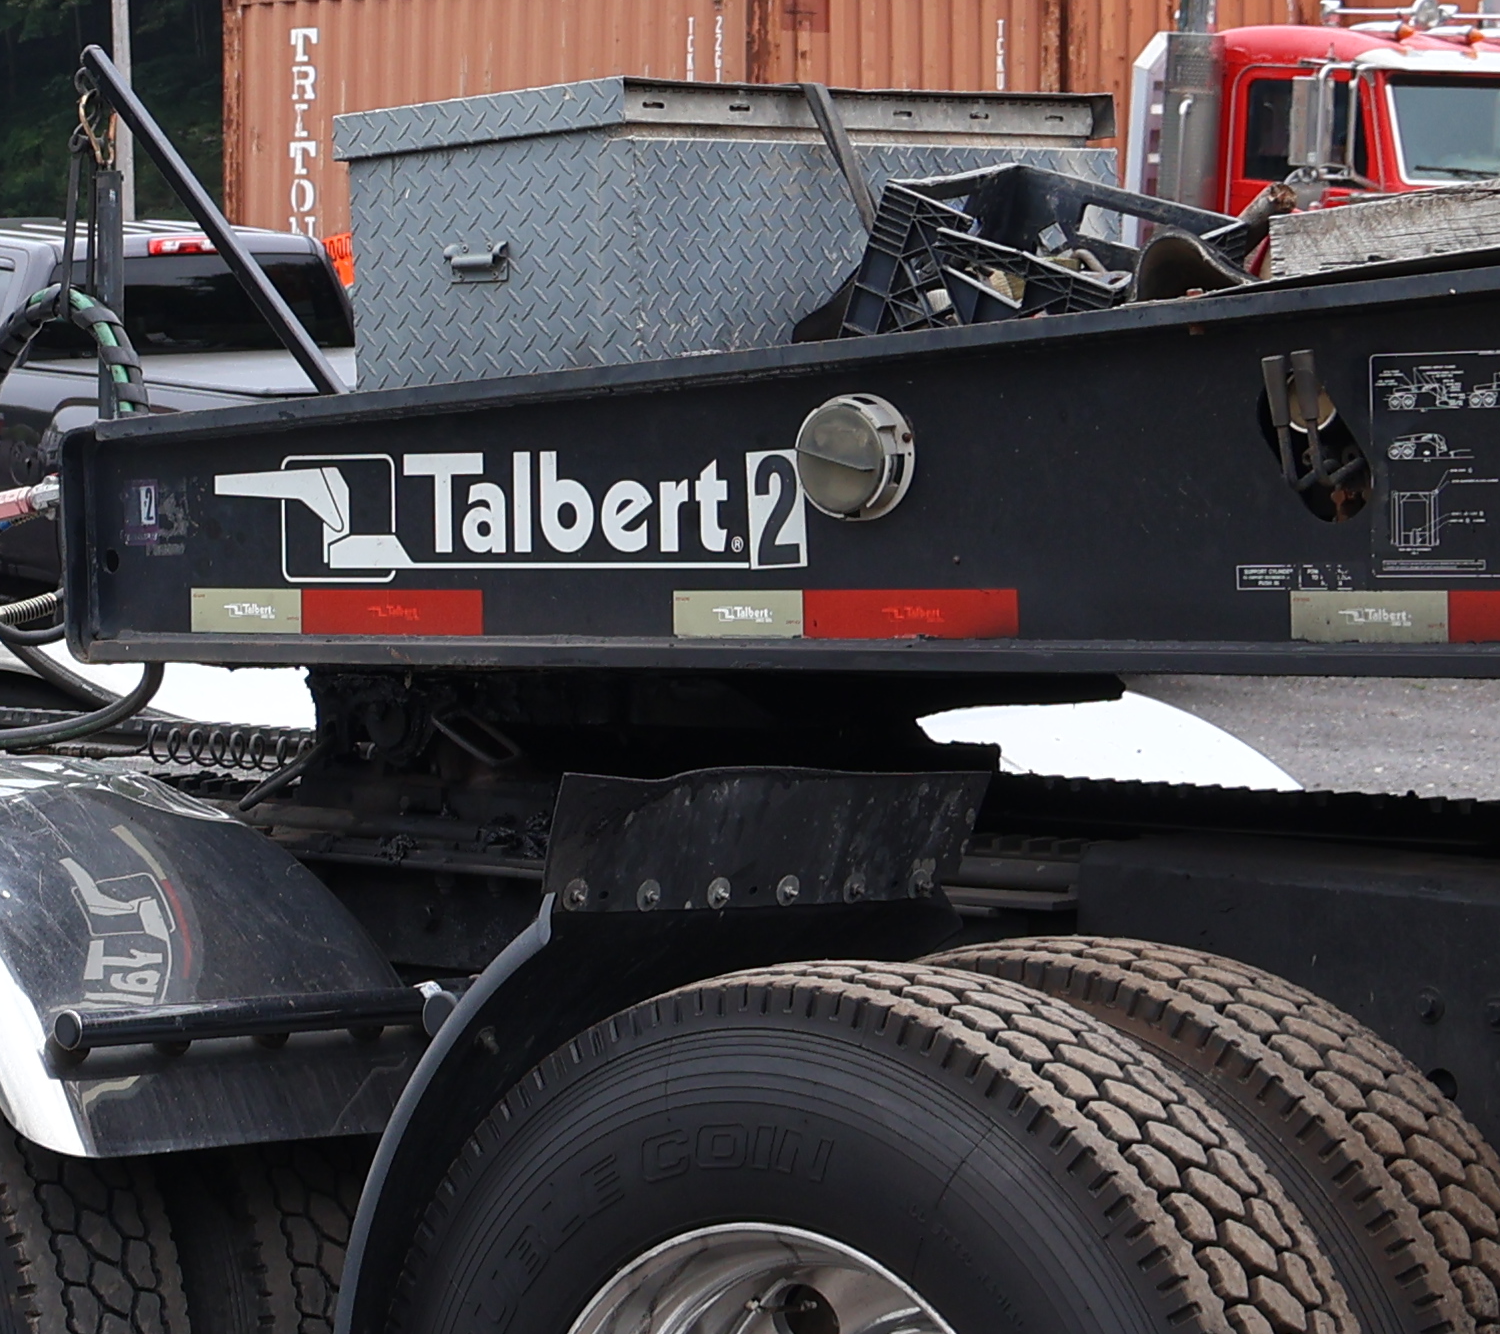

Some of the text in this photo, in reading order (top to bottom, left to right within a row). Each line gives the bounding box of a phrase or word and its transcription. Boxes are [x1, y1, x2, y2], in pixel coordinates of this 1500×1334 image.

[995, 18, 1005, 90] TCKU
[403, 451, 729, 554] Talbert
[242, 603, 272, 615] Talbert
[733, 606, 769, 618] Talbert
[1364, 608, 1407, 621] Talbert
[640, 1122, 838, 1184] COIN
